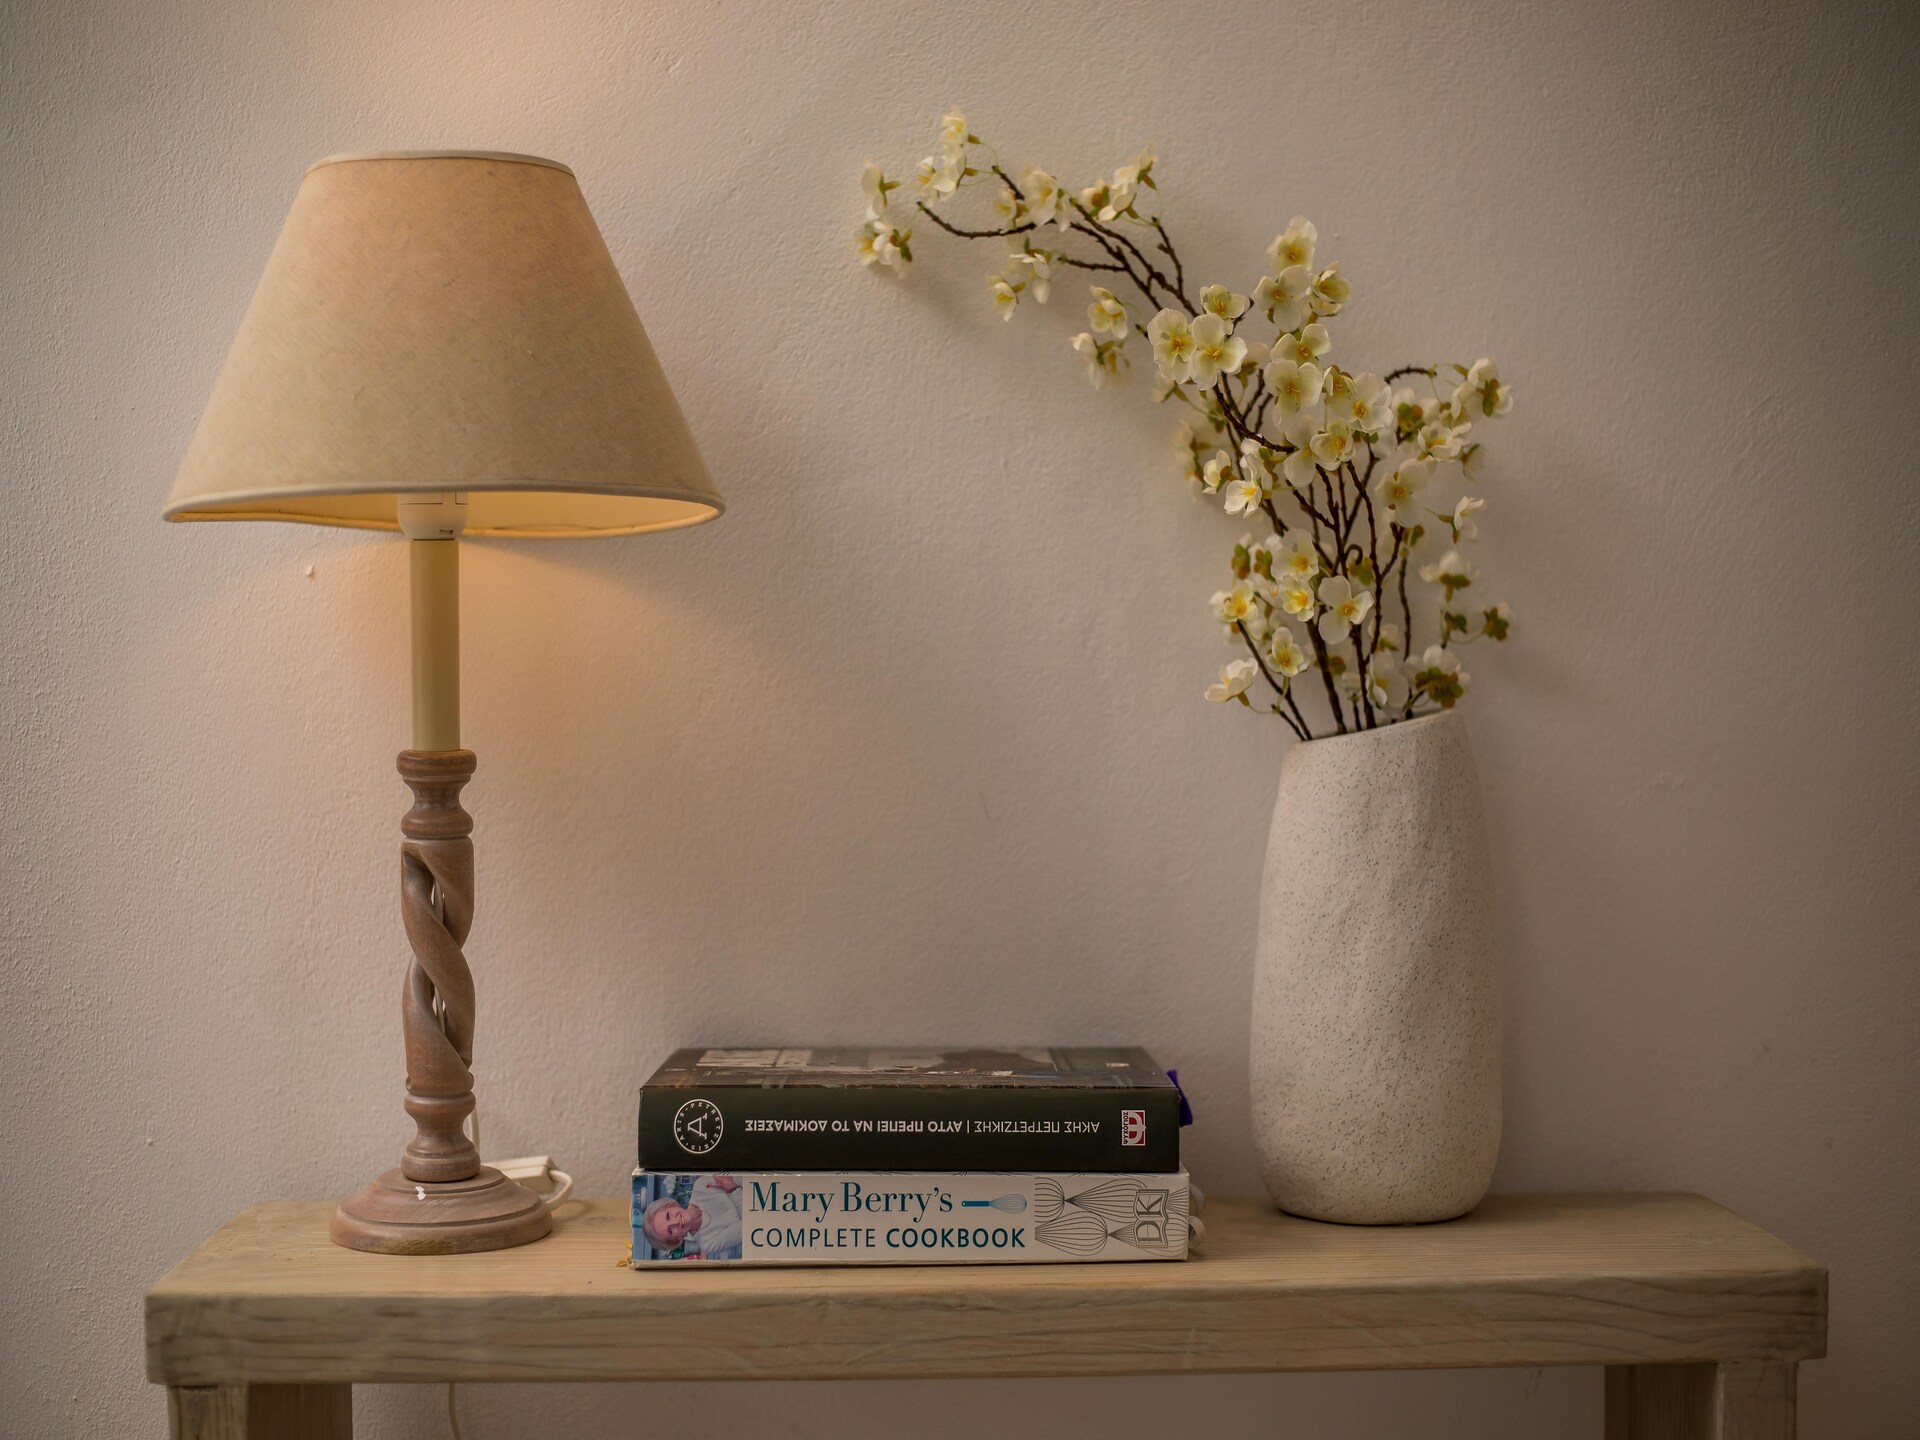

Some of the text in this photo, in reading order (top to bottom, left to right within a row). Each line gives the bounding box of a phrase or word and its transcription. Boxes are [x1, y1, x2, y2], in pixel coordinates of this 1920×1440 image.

[745, 1120, 963, 1132] ΑΥΤΟ ΠΡΕΠΕΙ ΝΑ ΤΟ ΔΟΚΙΜΑΣΕΙΣ
[974, 1121, 1100, 1133] ΑΚΗΣ ΠΕΤΡΕΤΖΙΚΗΣ
[749, 1181, 953, 1223] Mary Berry’s
[1136, 1193, 1164, 1243] DK
[750, 1228, 1026, 1248] COMPLETE COOKBOOK
